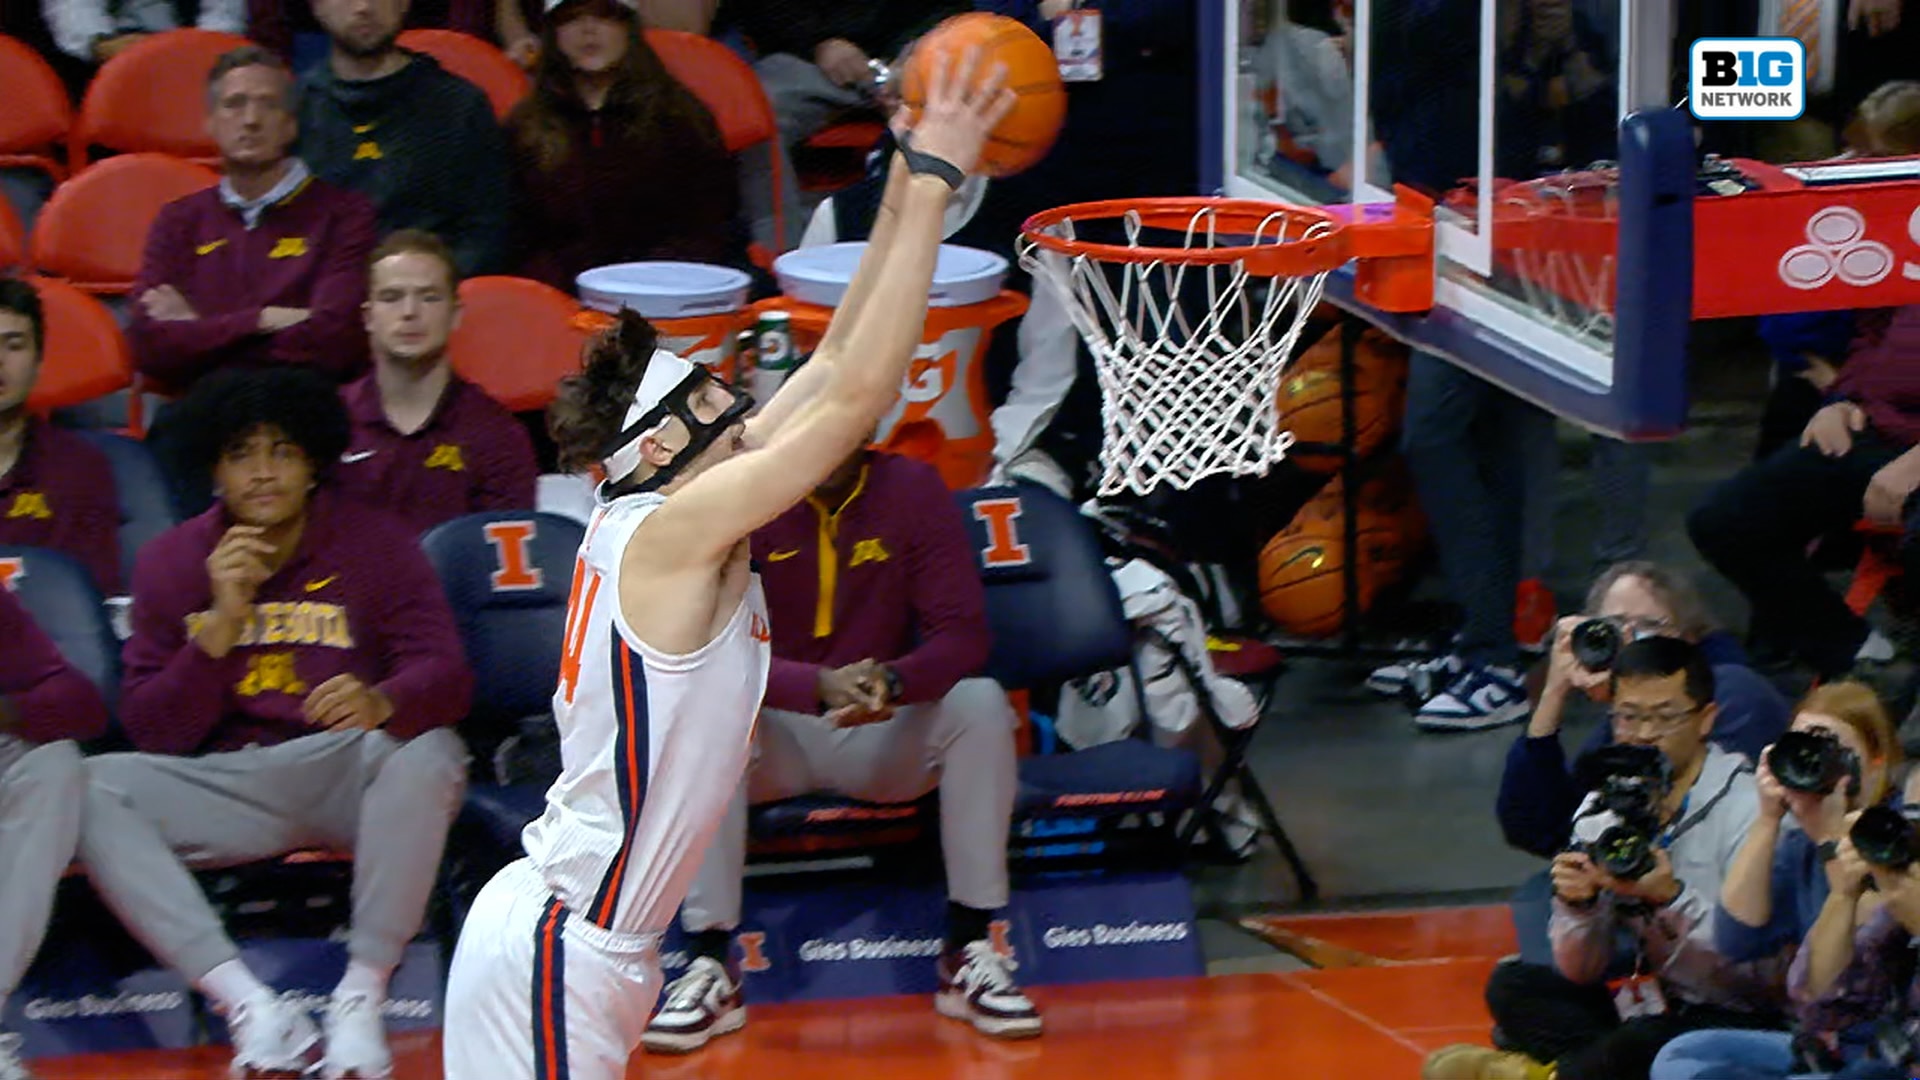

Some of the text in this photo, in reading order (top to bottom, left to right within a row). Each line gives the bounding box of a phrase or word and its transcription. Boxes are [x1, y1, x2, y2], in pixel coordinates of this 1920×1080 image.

[483, 520, 544, 592] I
[975, 497, 1032, 568] I
[1092, 920, 1188, 944] Business
